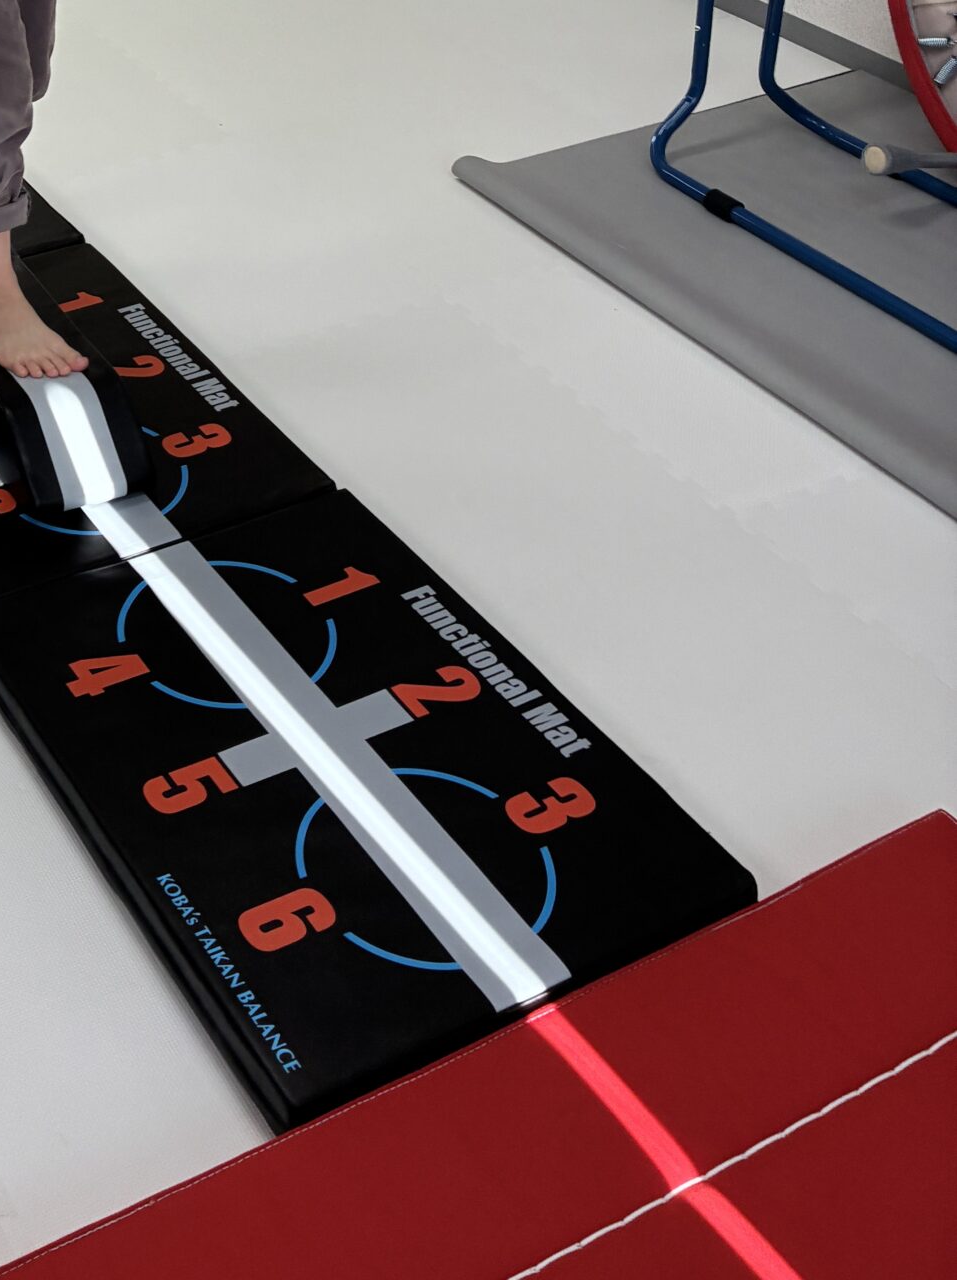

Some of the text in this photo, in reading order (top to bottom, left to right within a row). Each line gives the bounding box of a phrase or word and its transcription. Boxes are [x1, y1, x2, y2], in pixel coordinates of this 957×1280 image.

[59, 291, 232, 459] 1 2 3
[117, 303, 240, 412] Functional Mat
[304, 565, 596, 834] 1 2 3
[400, 584, 592, 758] Functional Mat
[66, 654, 336, 952] 4 5 6
[156, 873, 302, 1074] KOBA's TAIKAN BALANCE
